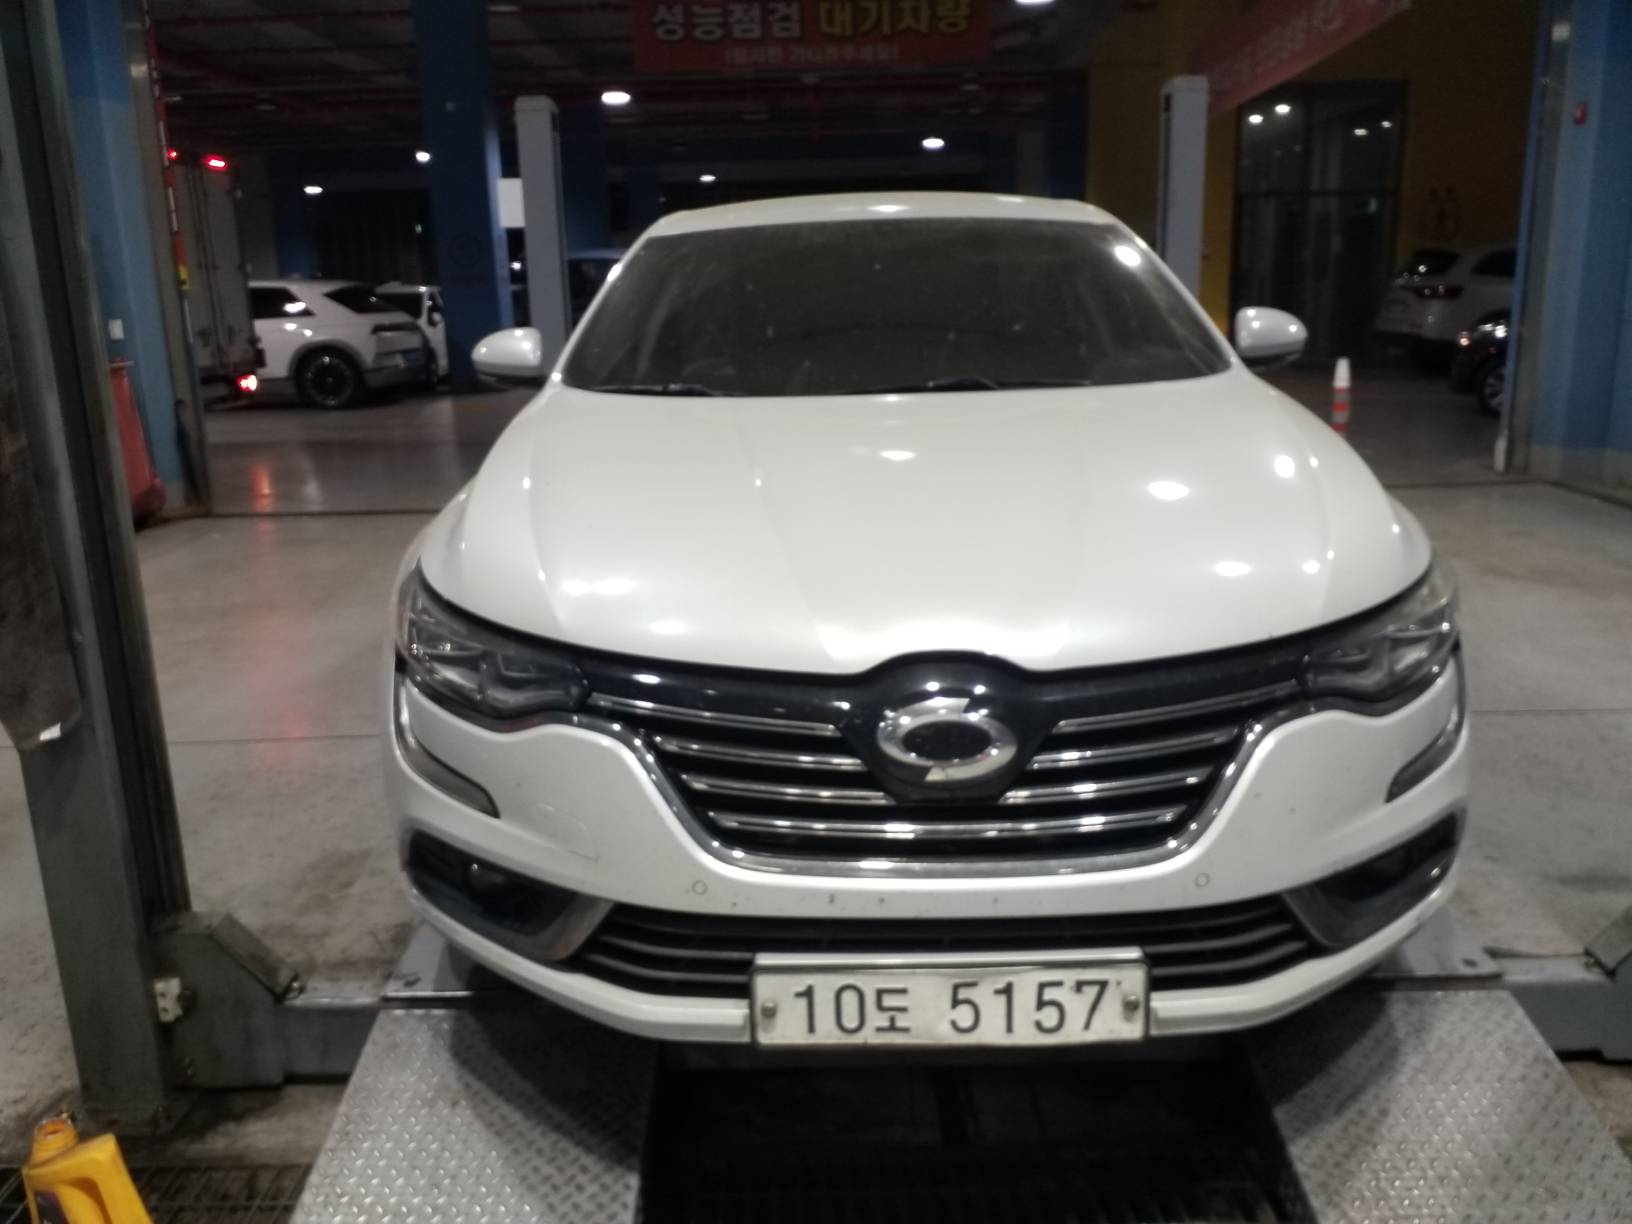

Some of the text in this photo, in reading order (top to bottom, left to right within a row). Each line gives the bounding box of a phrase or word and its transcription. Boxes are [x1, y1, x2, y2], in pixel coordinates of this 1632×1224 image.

[652, 0, 971, 41] 성능점검 대기차량
[794, 980, 1110, 1035] 10도 5157
